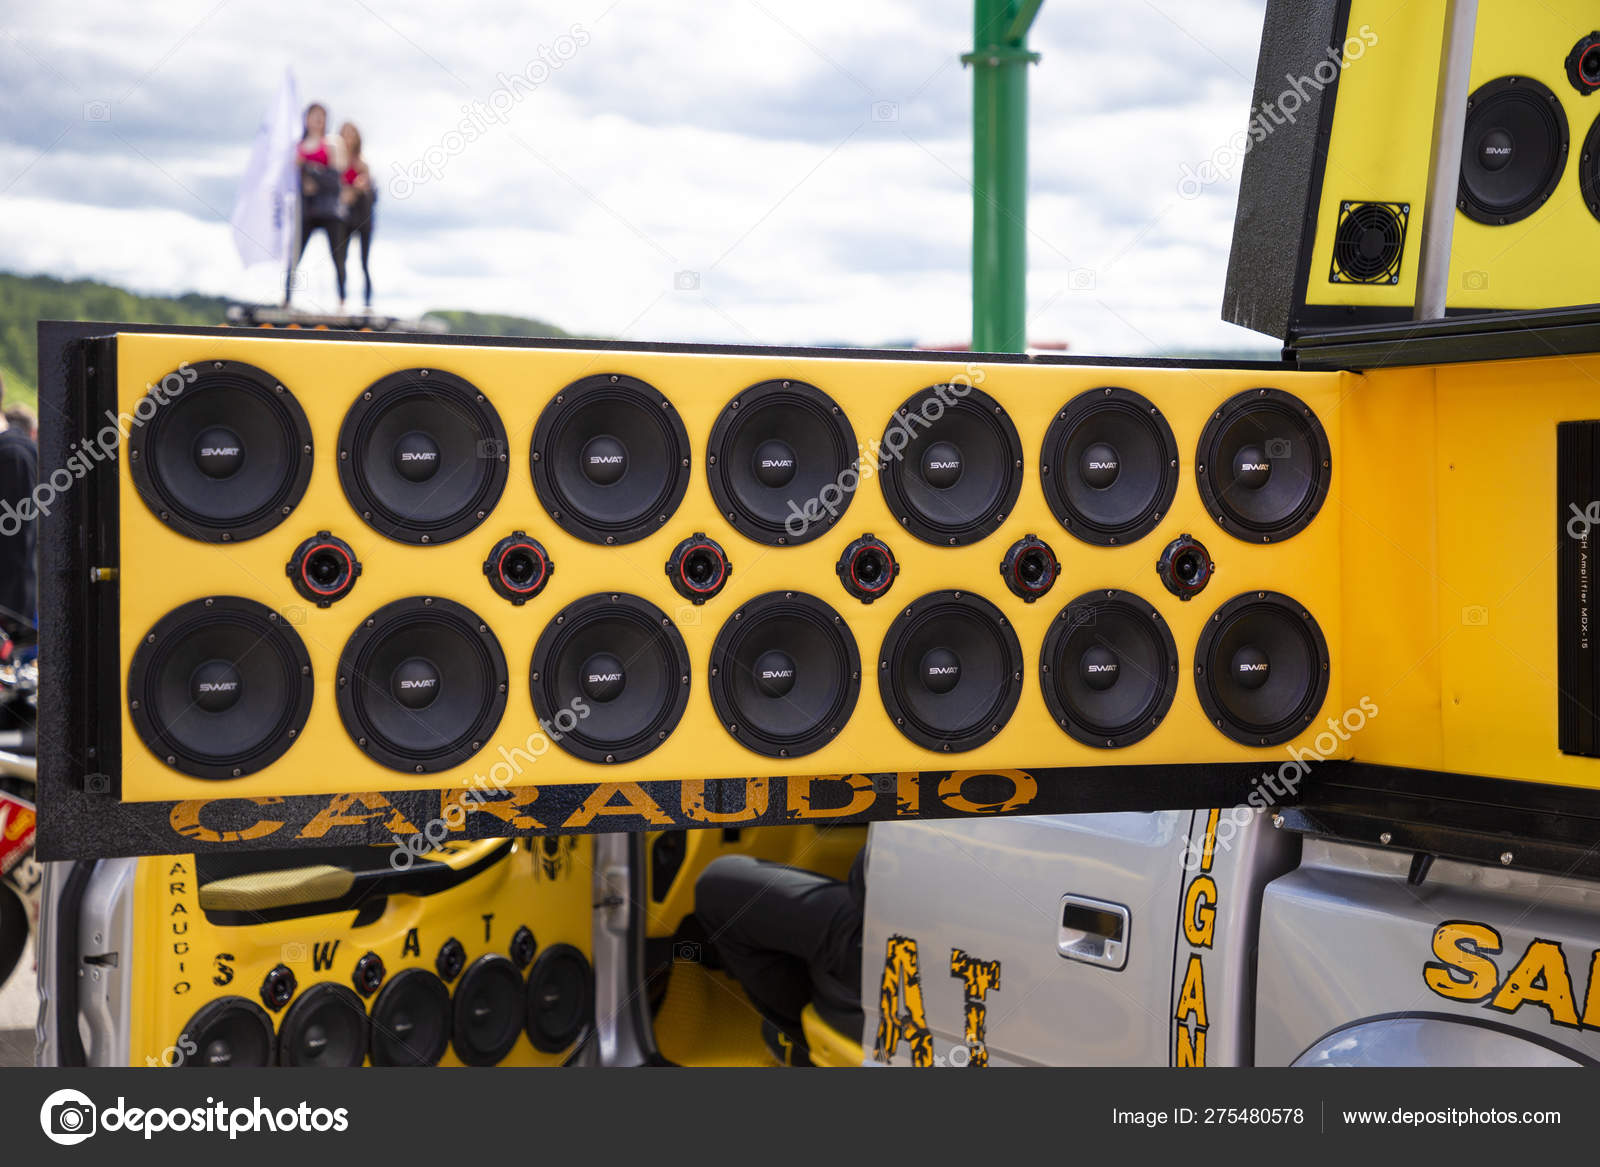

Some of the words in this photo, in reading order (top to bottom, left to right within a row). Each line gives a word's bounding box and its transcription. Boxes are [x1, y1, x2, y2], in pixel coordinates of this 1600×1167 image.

[201, 447, 240, 456] SWAT
[401, 452, 437, 461] SWAT
[590, 455, 625, 464] SWAT
[761, 459, 793, 468] SWAT
[930, 461, 961, 469] SWAT
[1089, 461, 1118, 470] SWAT
[1241, 463, 1269, 471] SWAT
[1580, 552, 1588, 604] Amplifier
[1580, 607, 1588, 649] MDX-15
[929, 667, 959, 675] SWAT
[1088, 664, 1117, 673] SWAT
[1239, 663, 1268, 672] SWAT
[588, 673, 622, 683] SWAT
[762, 670, 793, 679] SWAT
[200, 683, 237, 692] SWAT
[401, 680, 437, 689] SWAT
